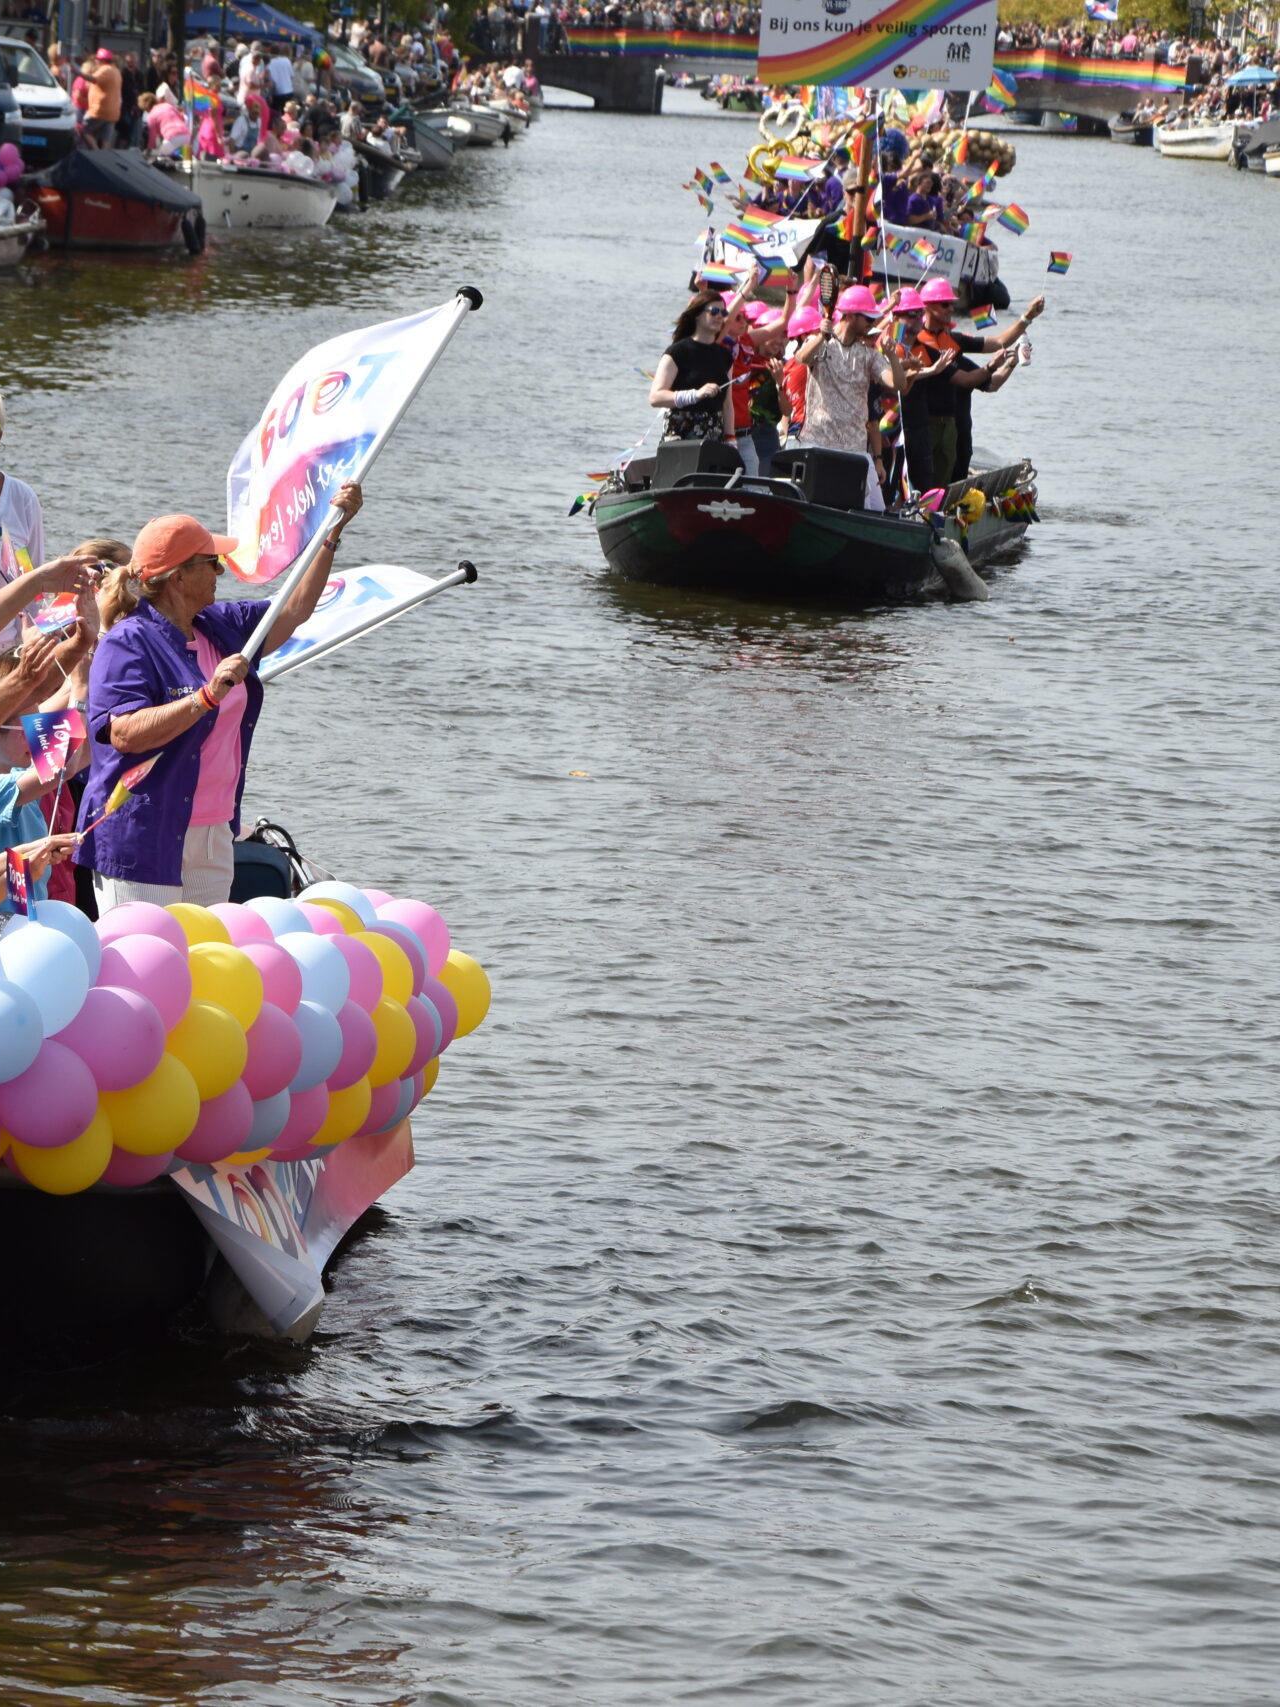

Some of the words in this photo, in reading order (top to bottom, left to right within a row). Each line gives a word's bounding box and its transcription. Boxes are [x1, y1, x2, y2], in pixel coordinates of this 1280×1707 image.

[769, 17, 788, 33] Bij
[793, 21, 820, 32] ons
[825, 18, 854, 33] kun
[857, 20, 872, 36] je
[876, 20, 918, 38] veilig
[922, 22, 988, 37] sporten!
[167, 685, 195, 696] Topaz
